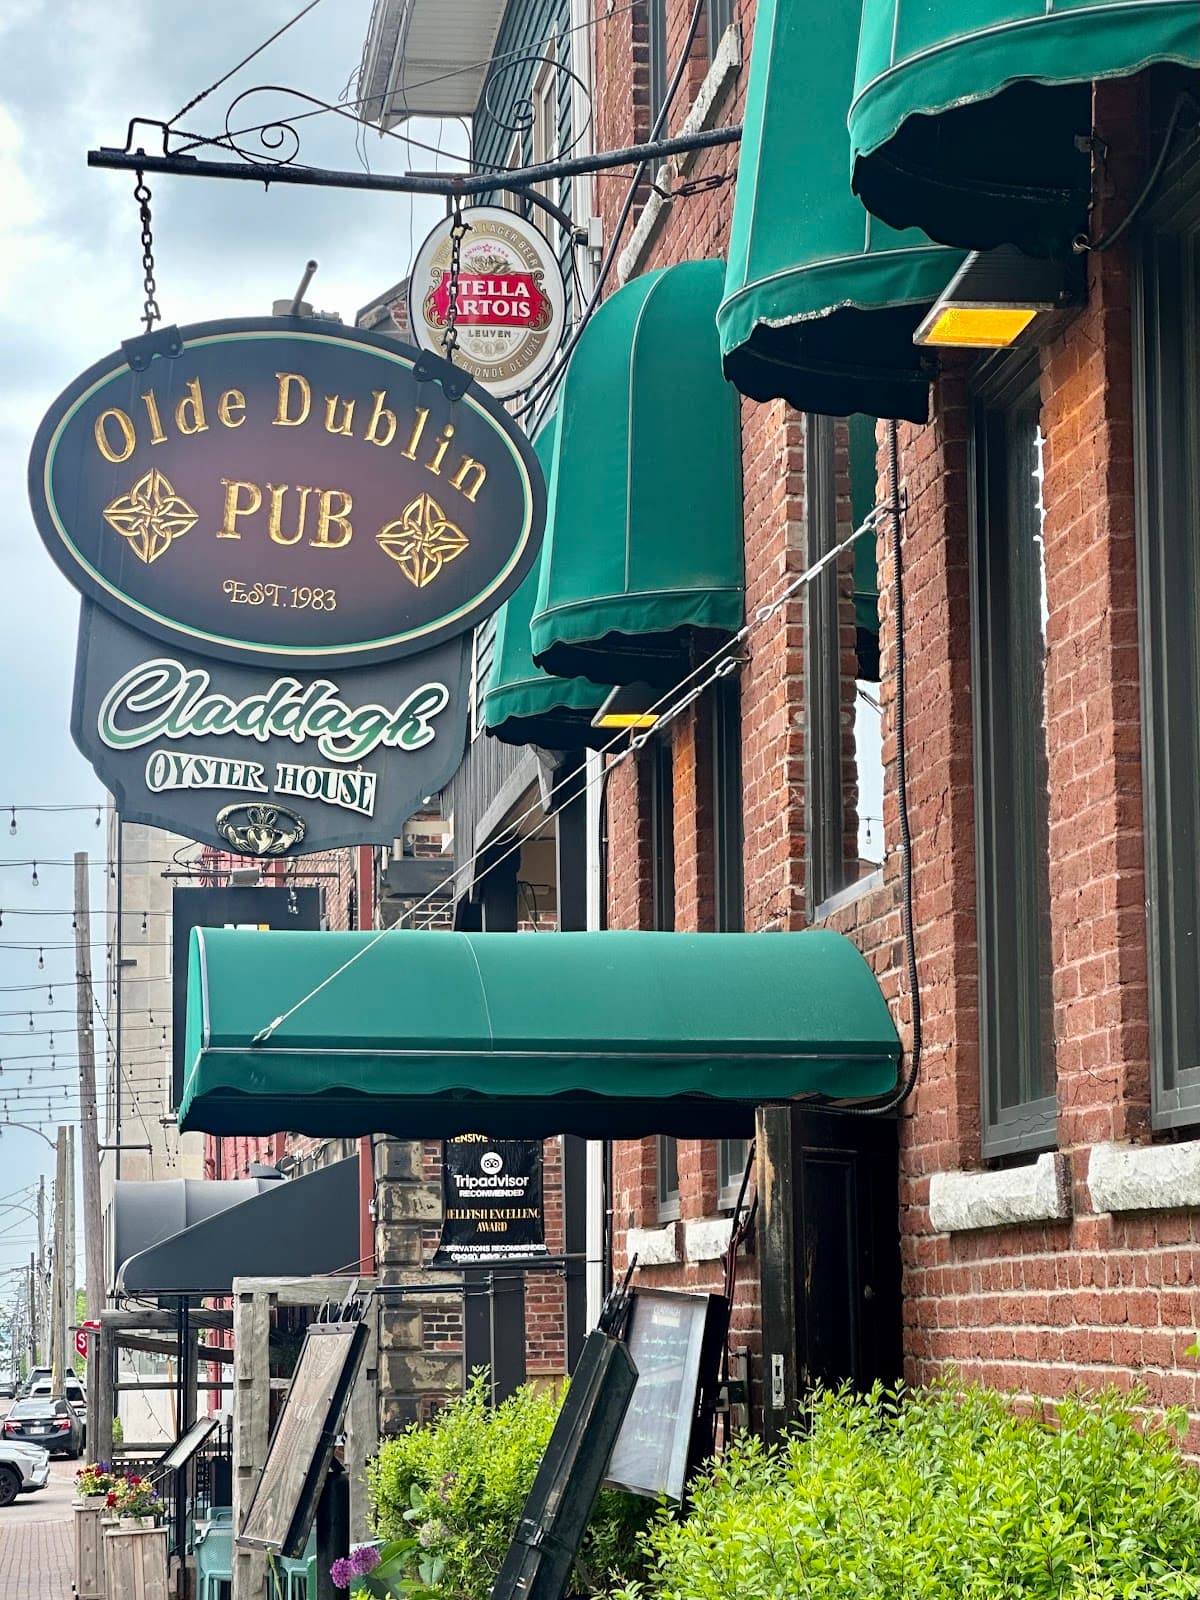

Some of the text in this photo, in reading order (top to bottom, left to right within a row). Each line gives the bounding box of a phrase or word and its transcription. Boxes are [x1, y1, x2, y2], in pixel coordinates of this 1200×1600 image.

[481, 223, 538, 266] LAGER BEER
[468, 329, 511, 338] LEUVEN
[95, 372, 489, 503] Olde Dublin
[216, 478, 353, 549] PUB
[97, 658, 450, 763] Claddagh
[145, 750, 377, 817] OYSTER HOUSE
[453, 1174, 529, 1190] Tripadvisor
[459, 1189, 524, 1198] RECOMMENDED
[476, 1221, 508, 1232] AWARD
[491, 1244, 546, 1252] RECOMMENDED
